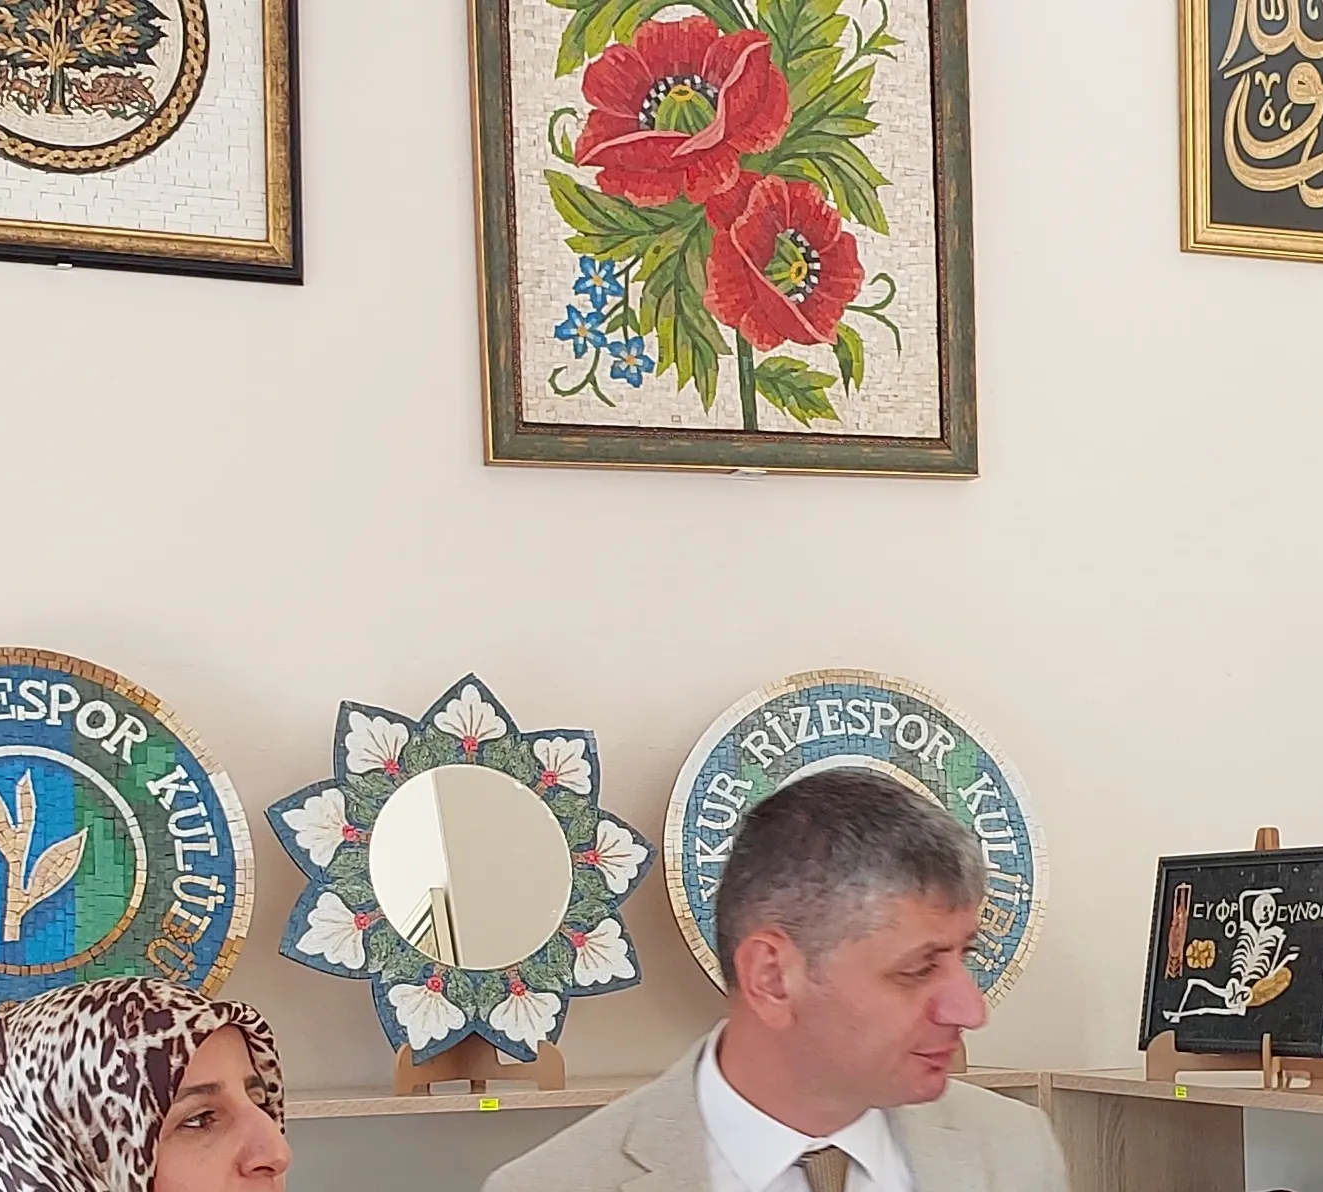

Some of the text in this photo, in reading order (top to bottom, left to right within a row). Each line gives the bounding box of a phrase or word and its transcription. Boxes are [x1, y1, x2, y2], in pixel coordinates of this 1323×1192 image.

[145, 764, 226, 983] KULÜBÜ
[695, 772, 754, 902] YKUR
[741, 698, 956, 769] RİZESPOR
